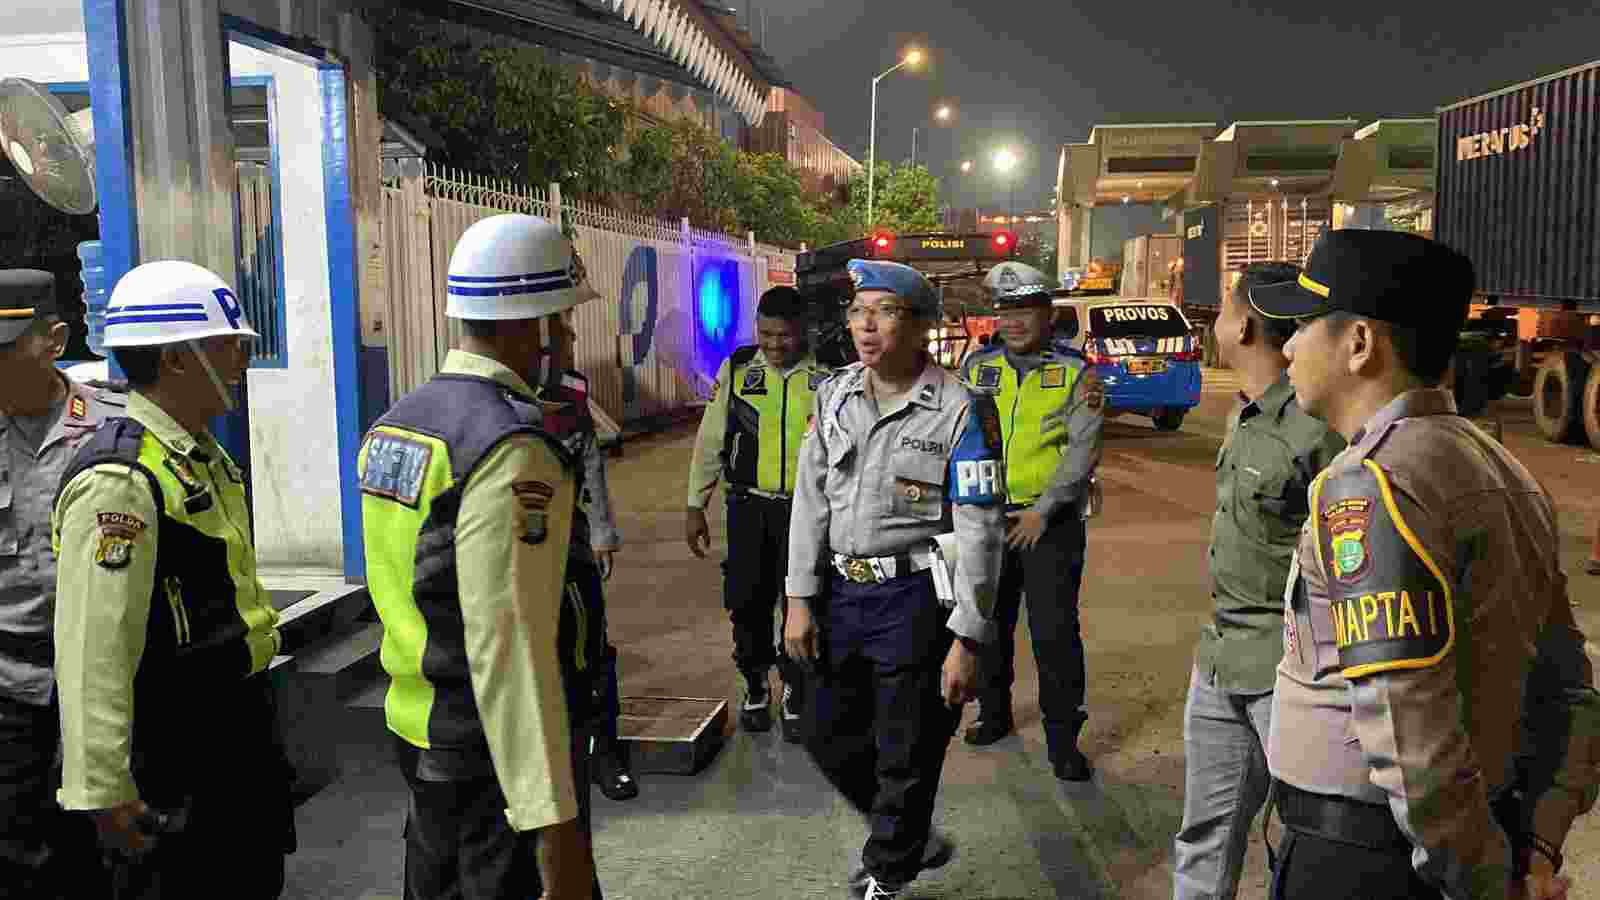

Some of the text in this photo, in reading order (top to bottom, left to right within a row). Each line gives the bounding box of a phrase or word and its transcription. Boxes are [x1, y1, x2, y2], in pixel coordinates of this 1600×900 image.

[921, 240, 965, 248] POLISI
[212, 288, 240, 329] P
[1103, 307, 1168, 322] PROVOS
